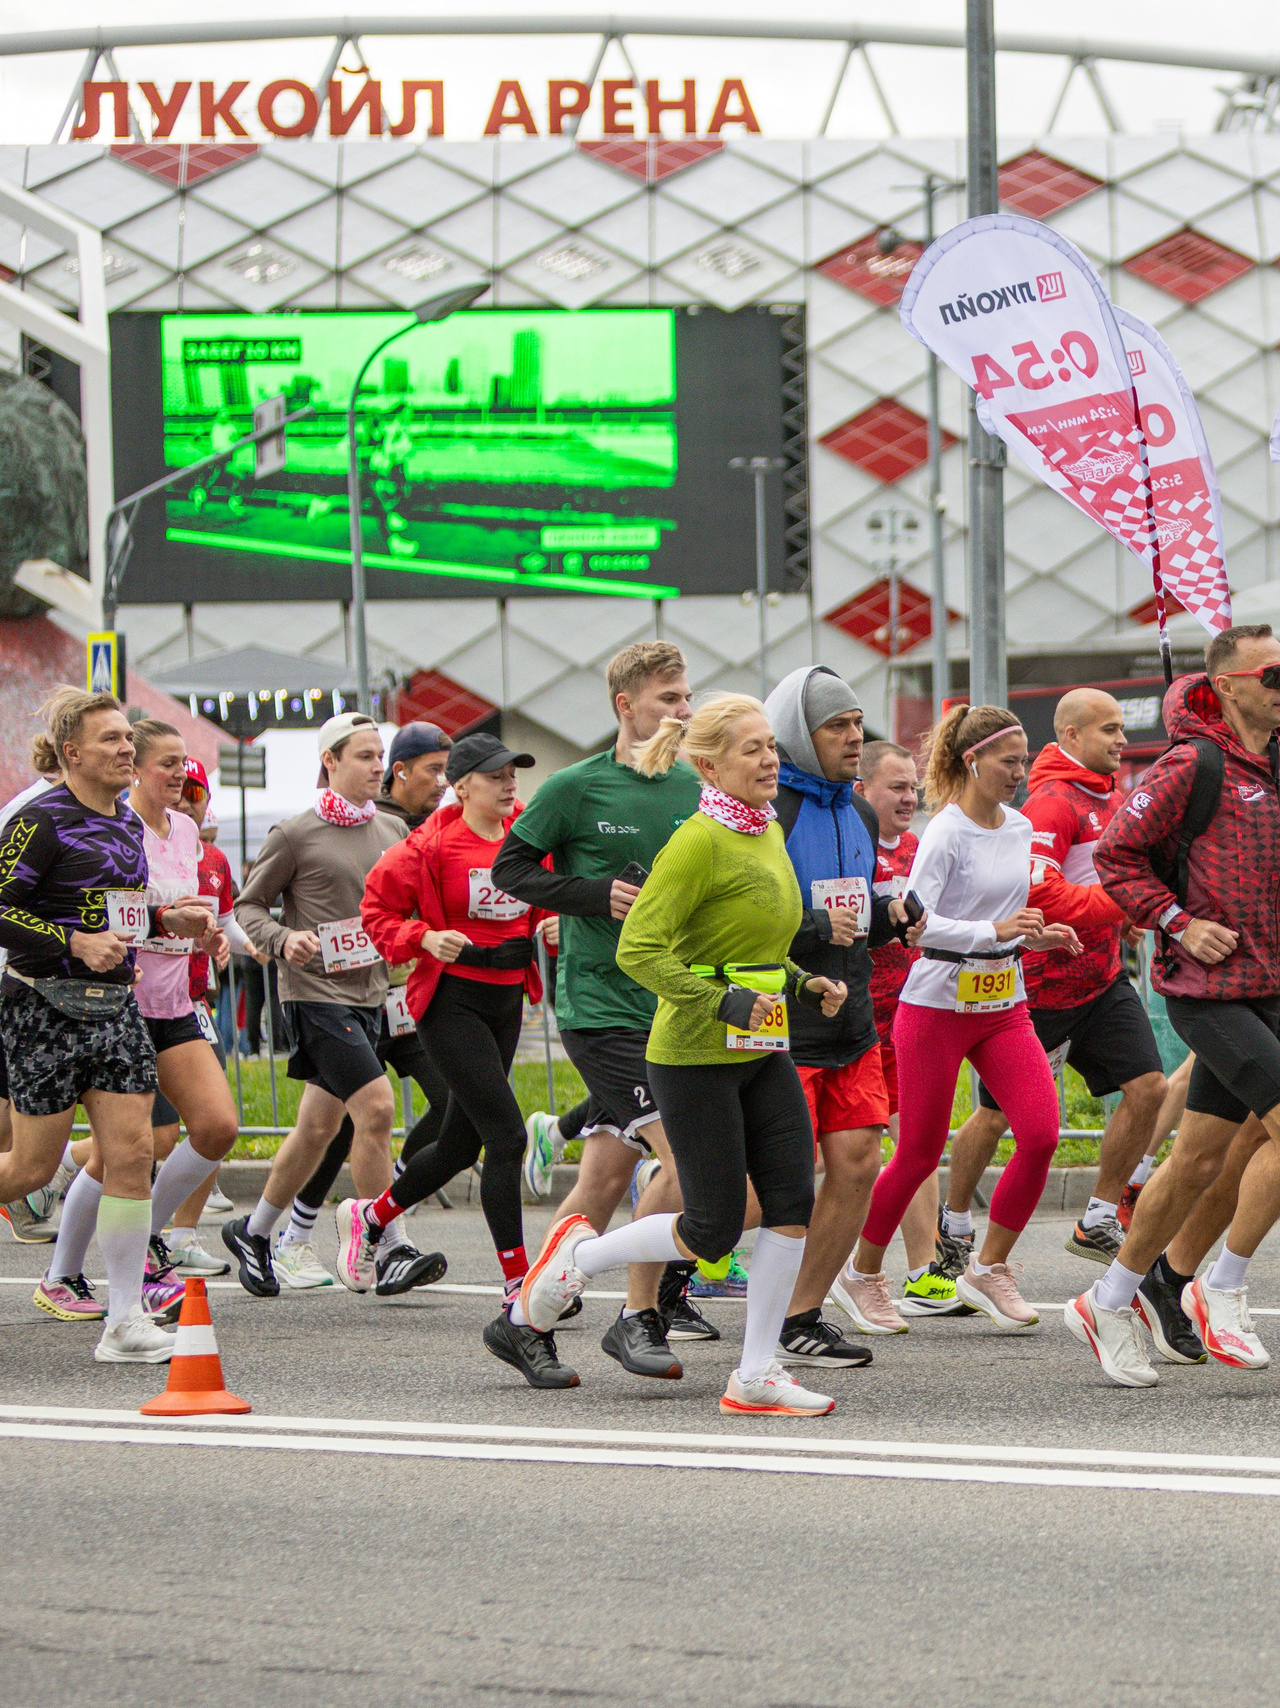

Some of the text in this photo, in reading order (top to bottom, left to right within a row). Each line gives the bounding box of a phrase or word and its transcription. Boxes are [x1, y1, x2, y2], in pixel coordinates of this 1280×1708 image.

[72, 67, 762, 139] ЛУКОЙЛ АРЕНА
[824, 893, 865, 914] 1567
[118, 906, 145, 927] 1611
[330, 931, 368, 953] 155
[972, 971, 1011, 994] 1931
[764, 1004, 783, 1027] 68
[633, 1086, 651, 1108] 2
